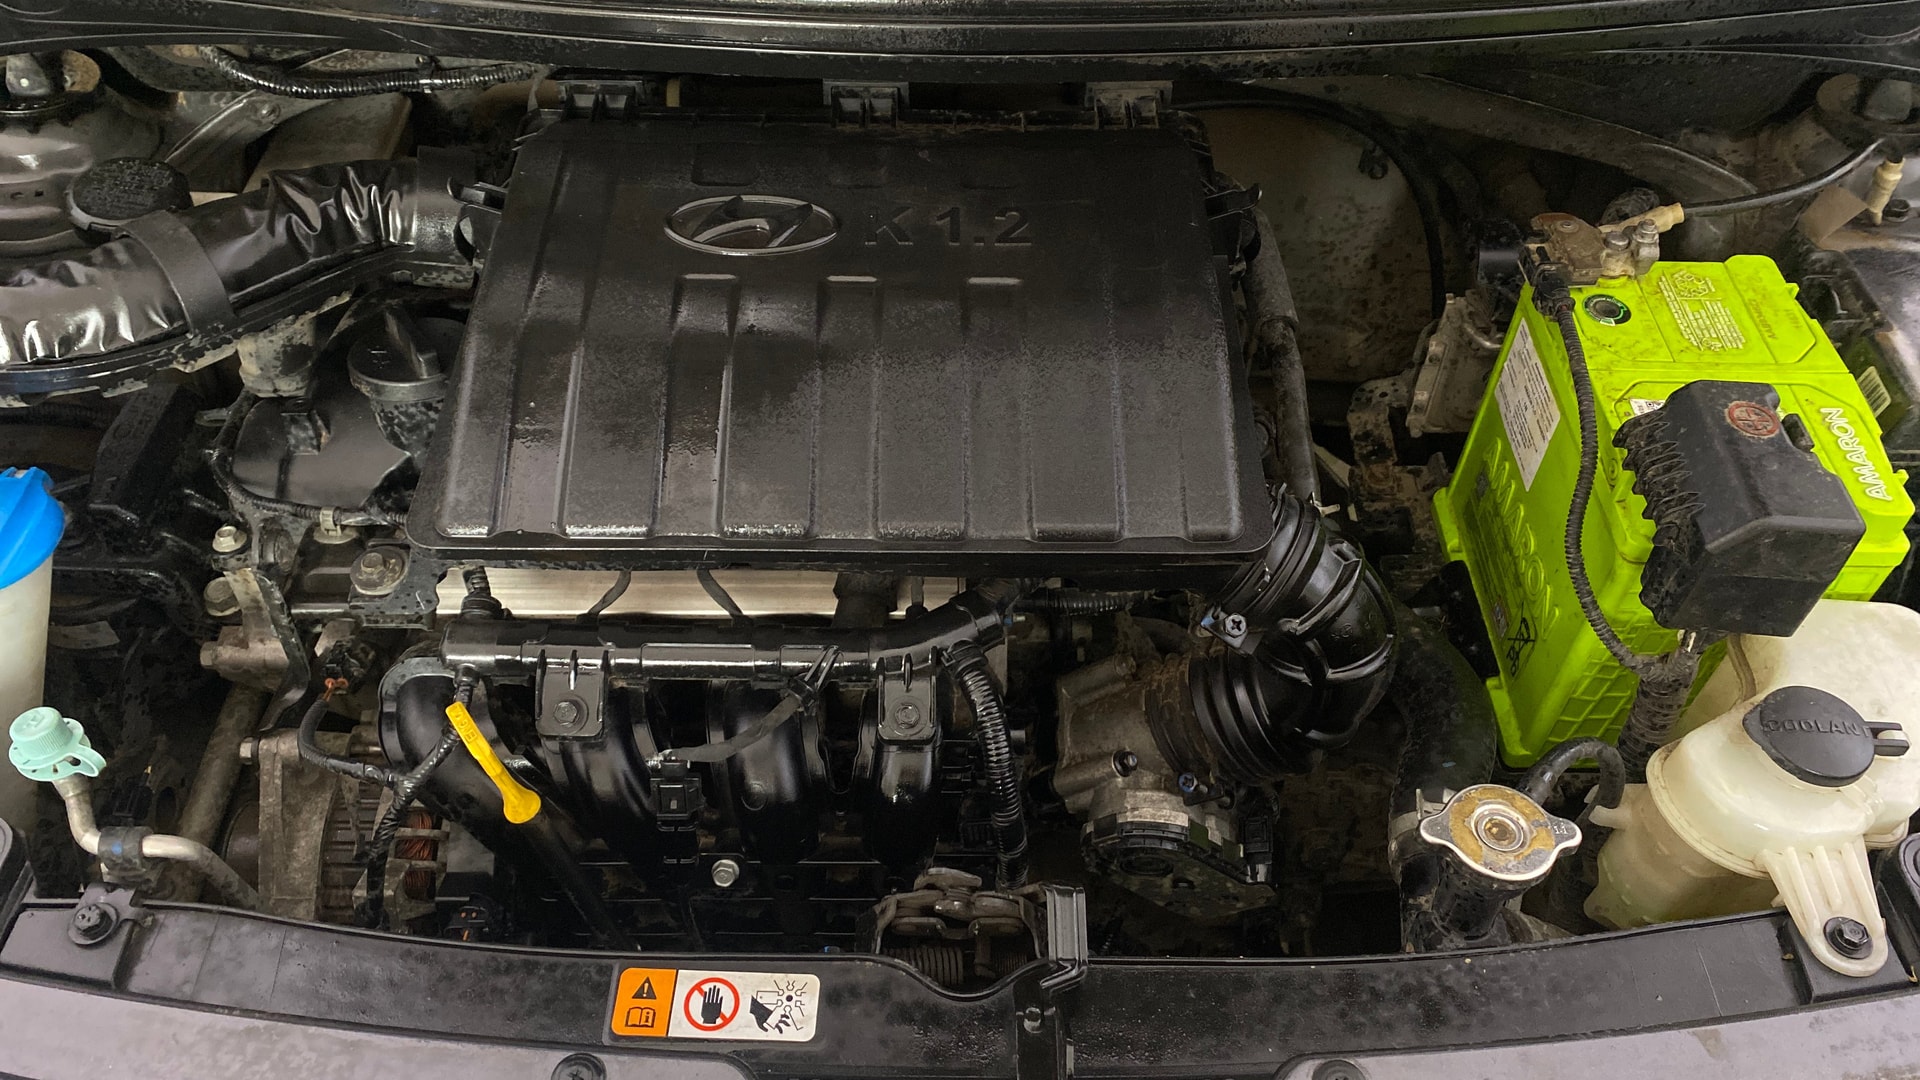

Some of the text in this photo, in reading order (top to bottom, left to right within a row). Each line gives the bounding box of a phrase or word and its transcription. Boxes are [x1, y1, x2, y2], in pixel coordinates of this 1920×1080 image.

[865, 206, 1032, 247] K 1.2
[1819, 407, 1894, 502] AMARON
[1481, 437, 1560, 640] AMARON
[1763, 719, 1871, 738] COOLANT
